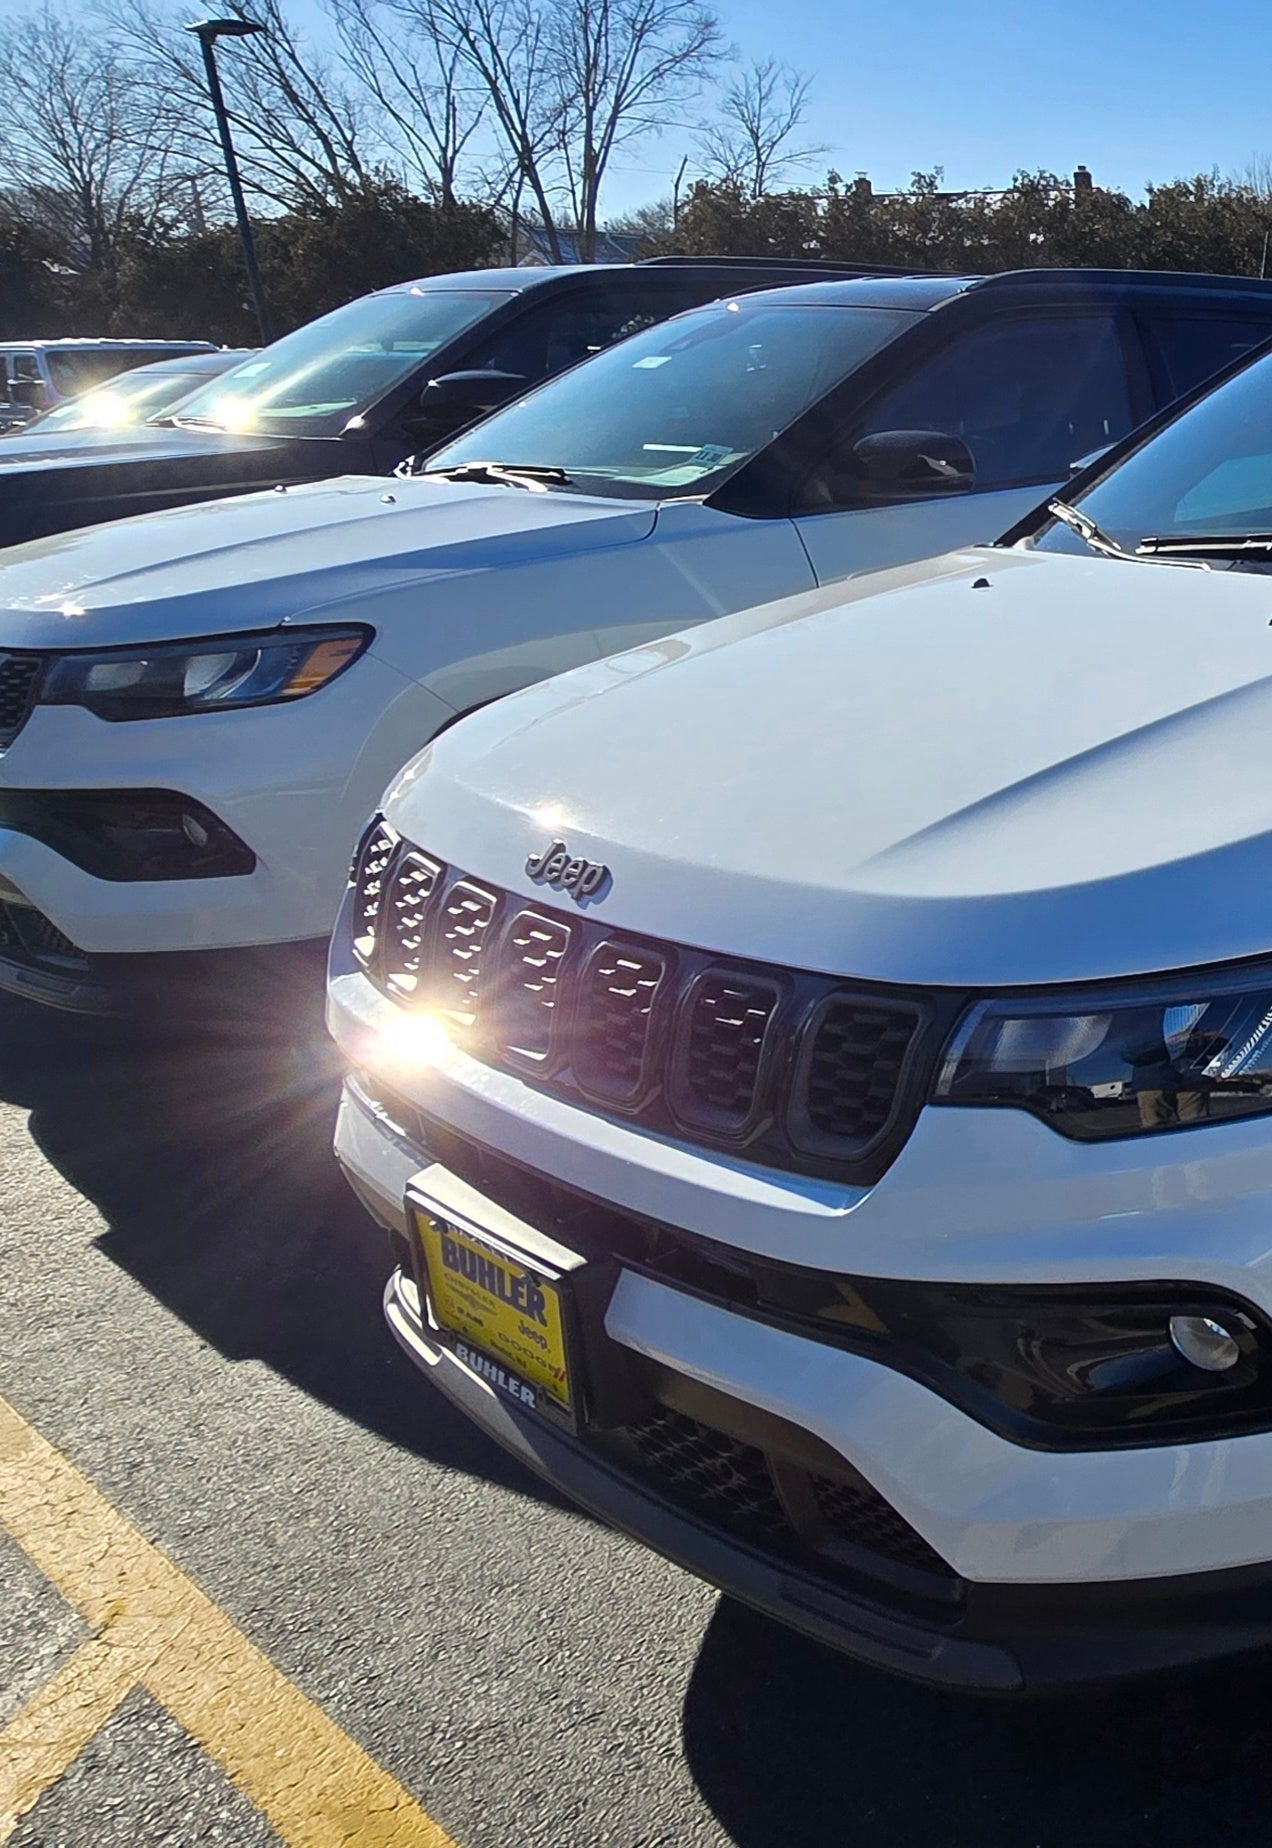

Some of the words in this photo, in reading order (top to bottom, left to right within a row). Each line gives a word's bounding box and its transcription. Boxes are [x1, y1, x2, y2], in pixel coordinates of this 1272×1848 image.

[525, 838, 608, 901] Jeep
[441, 1233, 548, 1327] BUHLER
[518, 1319, 548, 1350] Jeep
[455, 1342, 536, 1409] BUHLER
